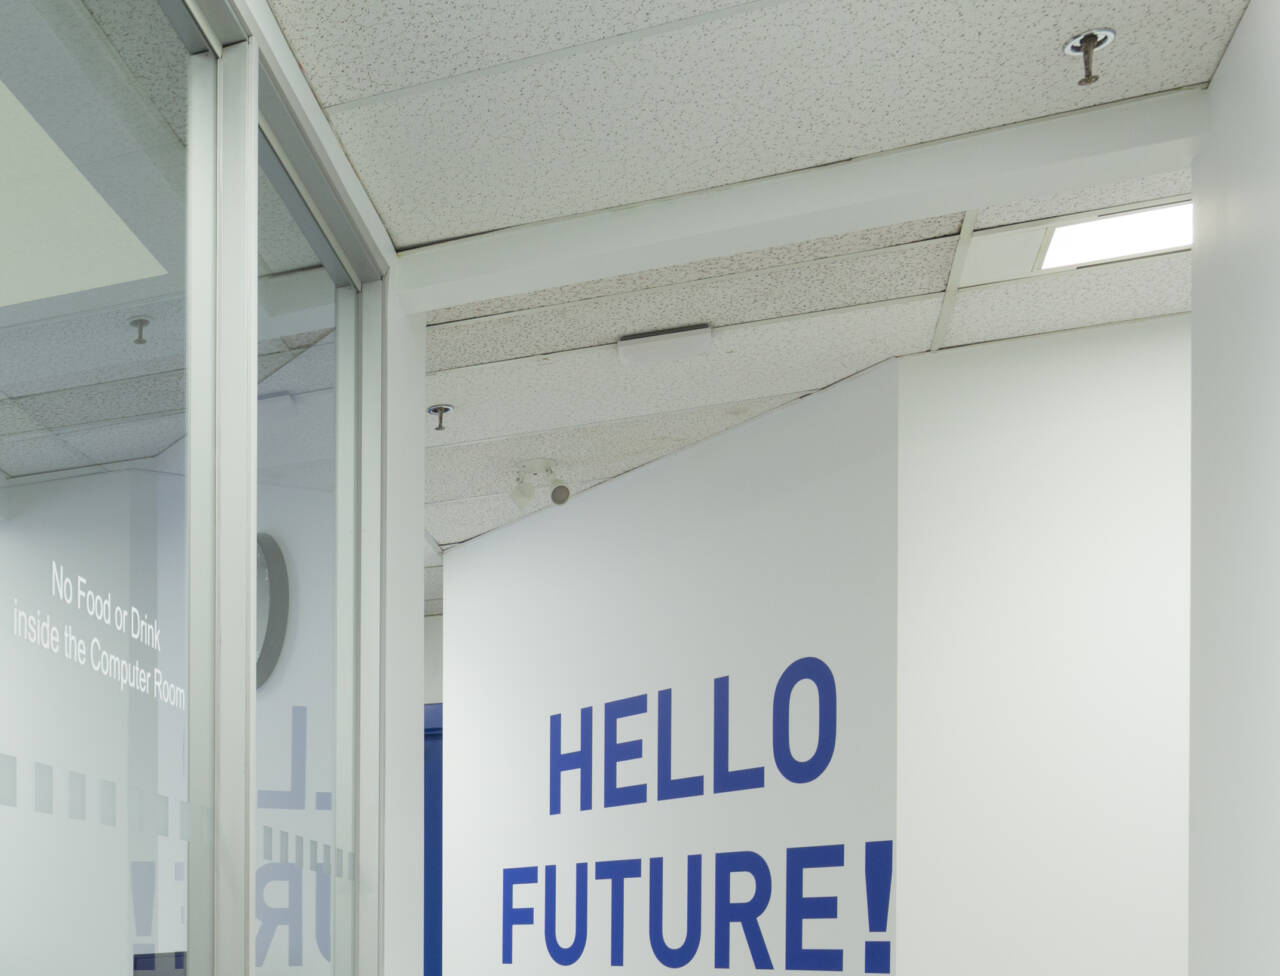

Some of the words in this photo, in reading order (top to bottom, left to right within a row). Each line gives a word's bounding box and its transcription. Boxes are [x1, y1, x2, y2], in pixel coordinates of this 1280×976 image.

[13, 598, 60, 653] inside
[64, 625, 86, 665] the
[90, 637, 151, 691] Computer
[154, 668, 186, 711] Room
[51, 560, 73, 604] No
[77, 575, 111, 625] Food
[114, 605, 128, 633] or
[131, 606, 161, 652] Drink
[549, 656, 837, 816] HELLO
[502, 840, 893, 974] FUTURE!
